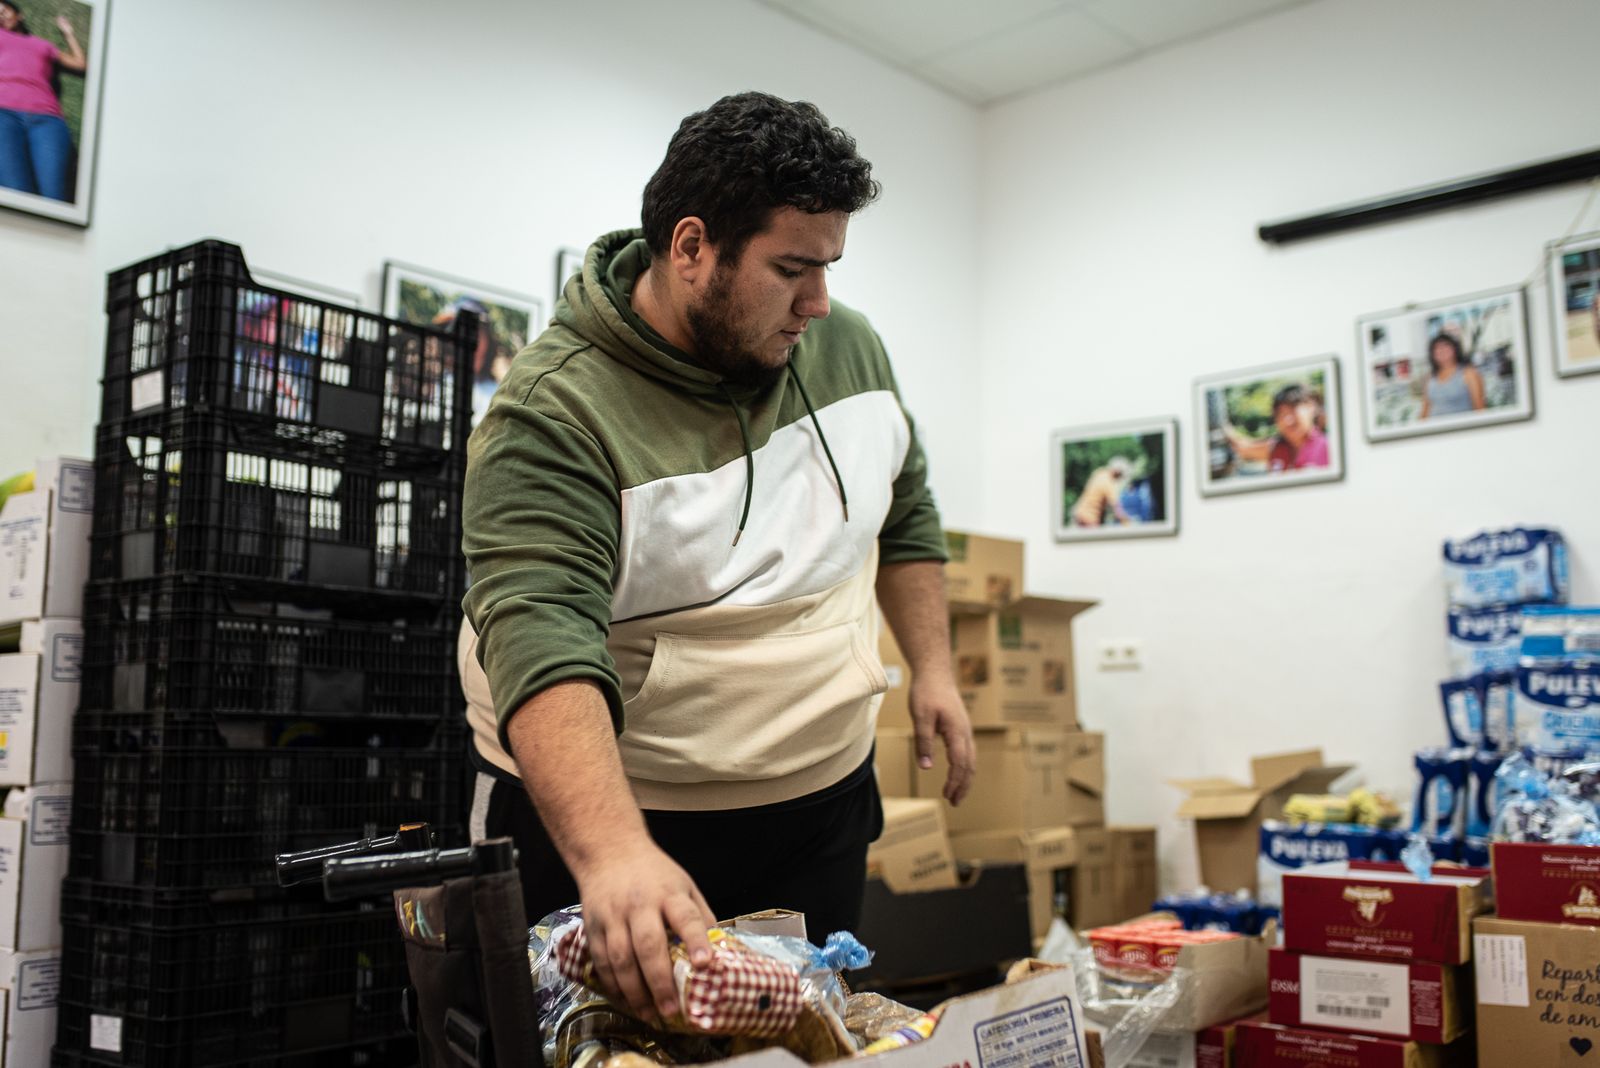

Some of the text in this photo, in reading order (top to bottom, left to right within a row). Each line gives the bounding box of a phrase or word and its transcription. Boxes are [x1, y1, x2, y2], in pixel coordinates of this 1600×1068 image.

[1271, 837, 1348, 860] PULEVA
[1536, 988, 1568, 1001] con
[1540, 1003, 1563, 1024] de
